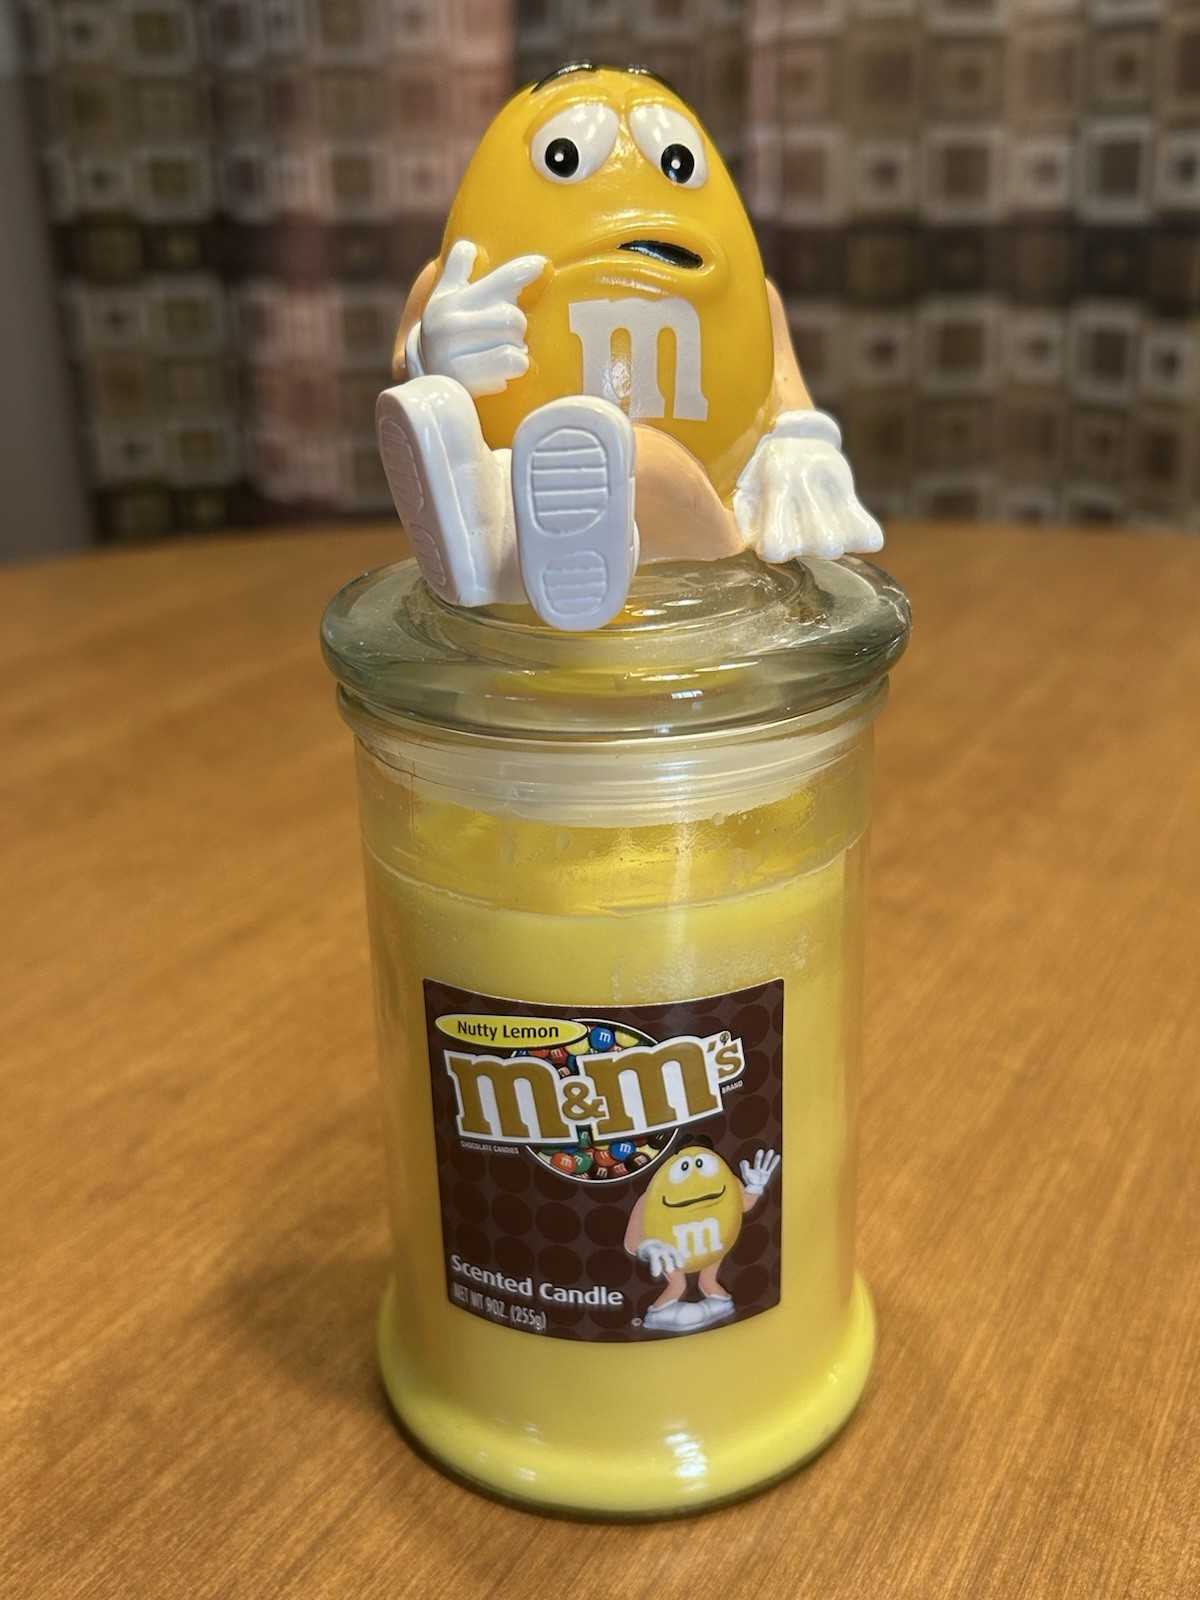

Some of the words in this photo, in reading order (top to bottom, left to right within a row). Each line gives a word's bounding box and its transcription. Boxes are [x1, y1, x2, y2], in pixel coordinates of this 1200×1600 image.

[568, 297, 709, 421] m
[457, 1020, 498, 1041] Nutty
[503, 1024, 559, 1039] Lemon
[599, 1030, 612, 1043] m
[721, 1080, 744, 1095] BRAND
[460, 1140, 493, 1152] CHOCOLATE
[493, 1145, 520, 1155] CANDIES
[619, 1142, 632, 1154] m
[672, 1217, 724, 1259] m
[451, 1253, 534, 1297] Scented
[539, 1282, 624, 1306] Candle
[453, 1282, 470, 1303] NET
[470, 1292, 485, 1310] WT
[510, 1304, 547, 1331] (255g)
